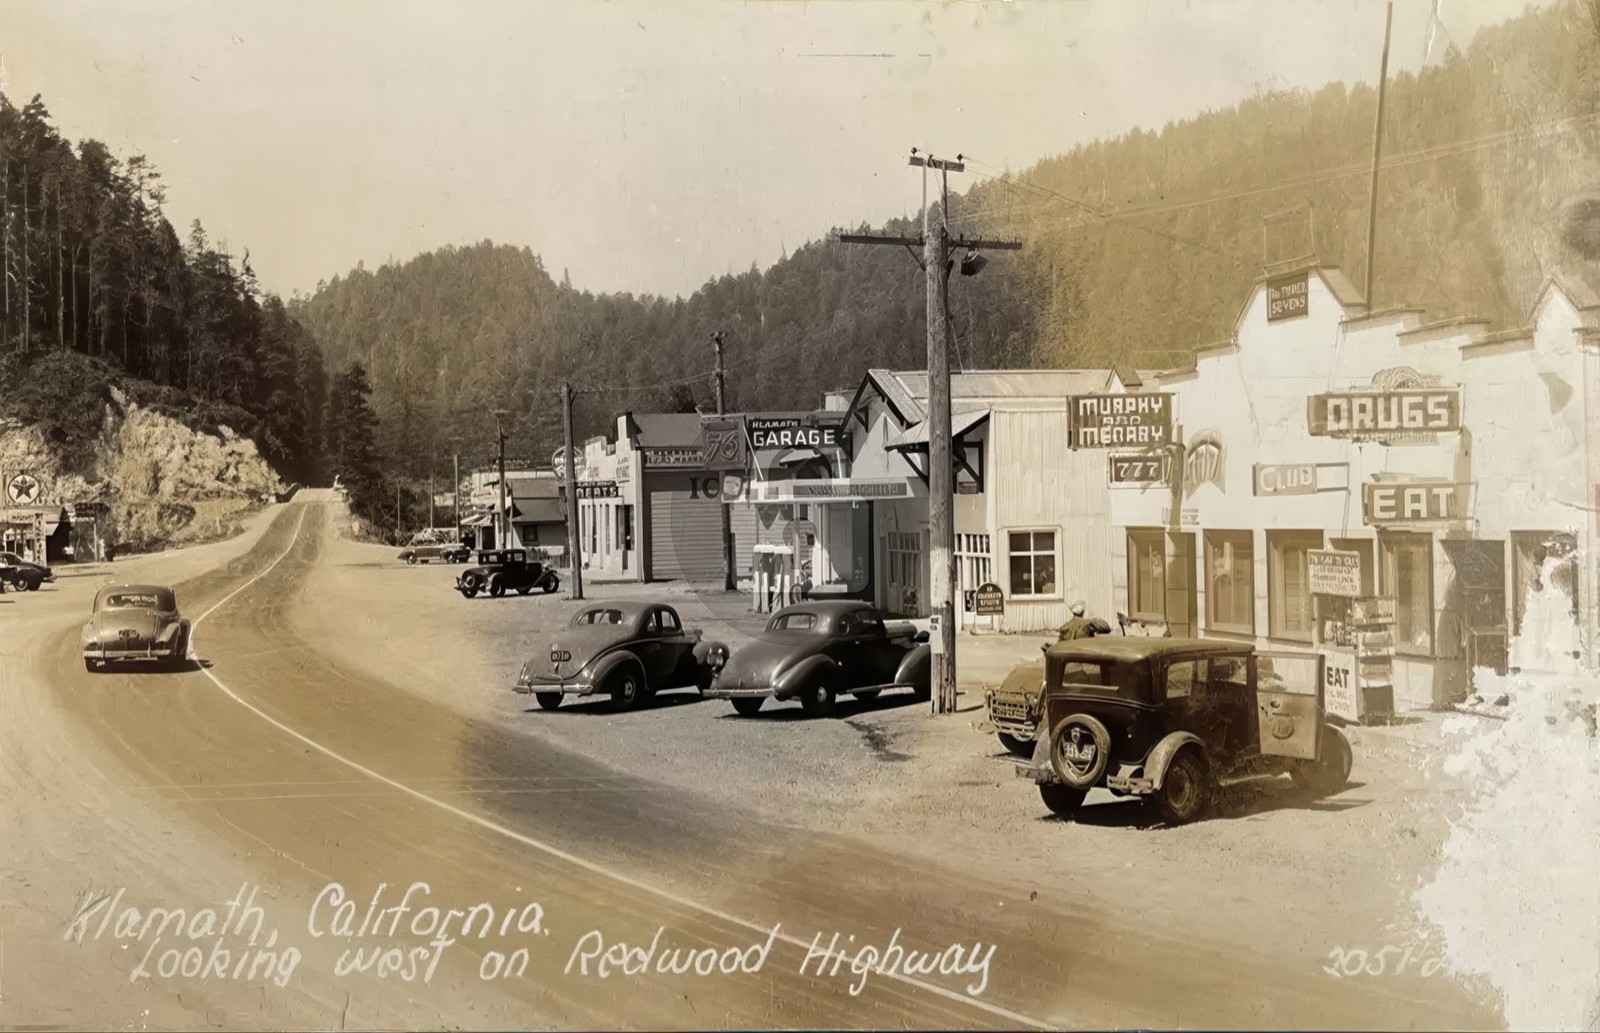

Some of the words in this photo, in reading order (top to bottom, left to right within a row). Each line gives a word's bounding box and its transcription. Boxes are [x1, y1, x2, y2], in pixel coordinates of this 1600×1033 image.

[1080, 397, 1162, 415] MURPHY
[1327, 395, 1449, 430] DRUGS
[703, 430, 739, 462] 76
[753, 429, 835, 446] GARAGE
[1117, 462, 1159, 478] 777
[1260, 466, 1313, 491] CLUB
[1373, 488, 1453, 518] EAT
[1326, 666, 1349, 688] EAT
